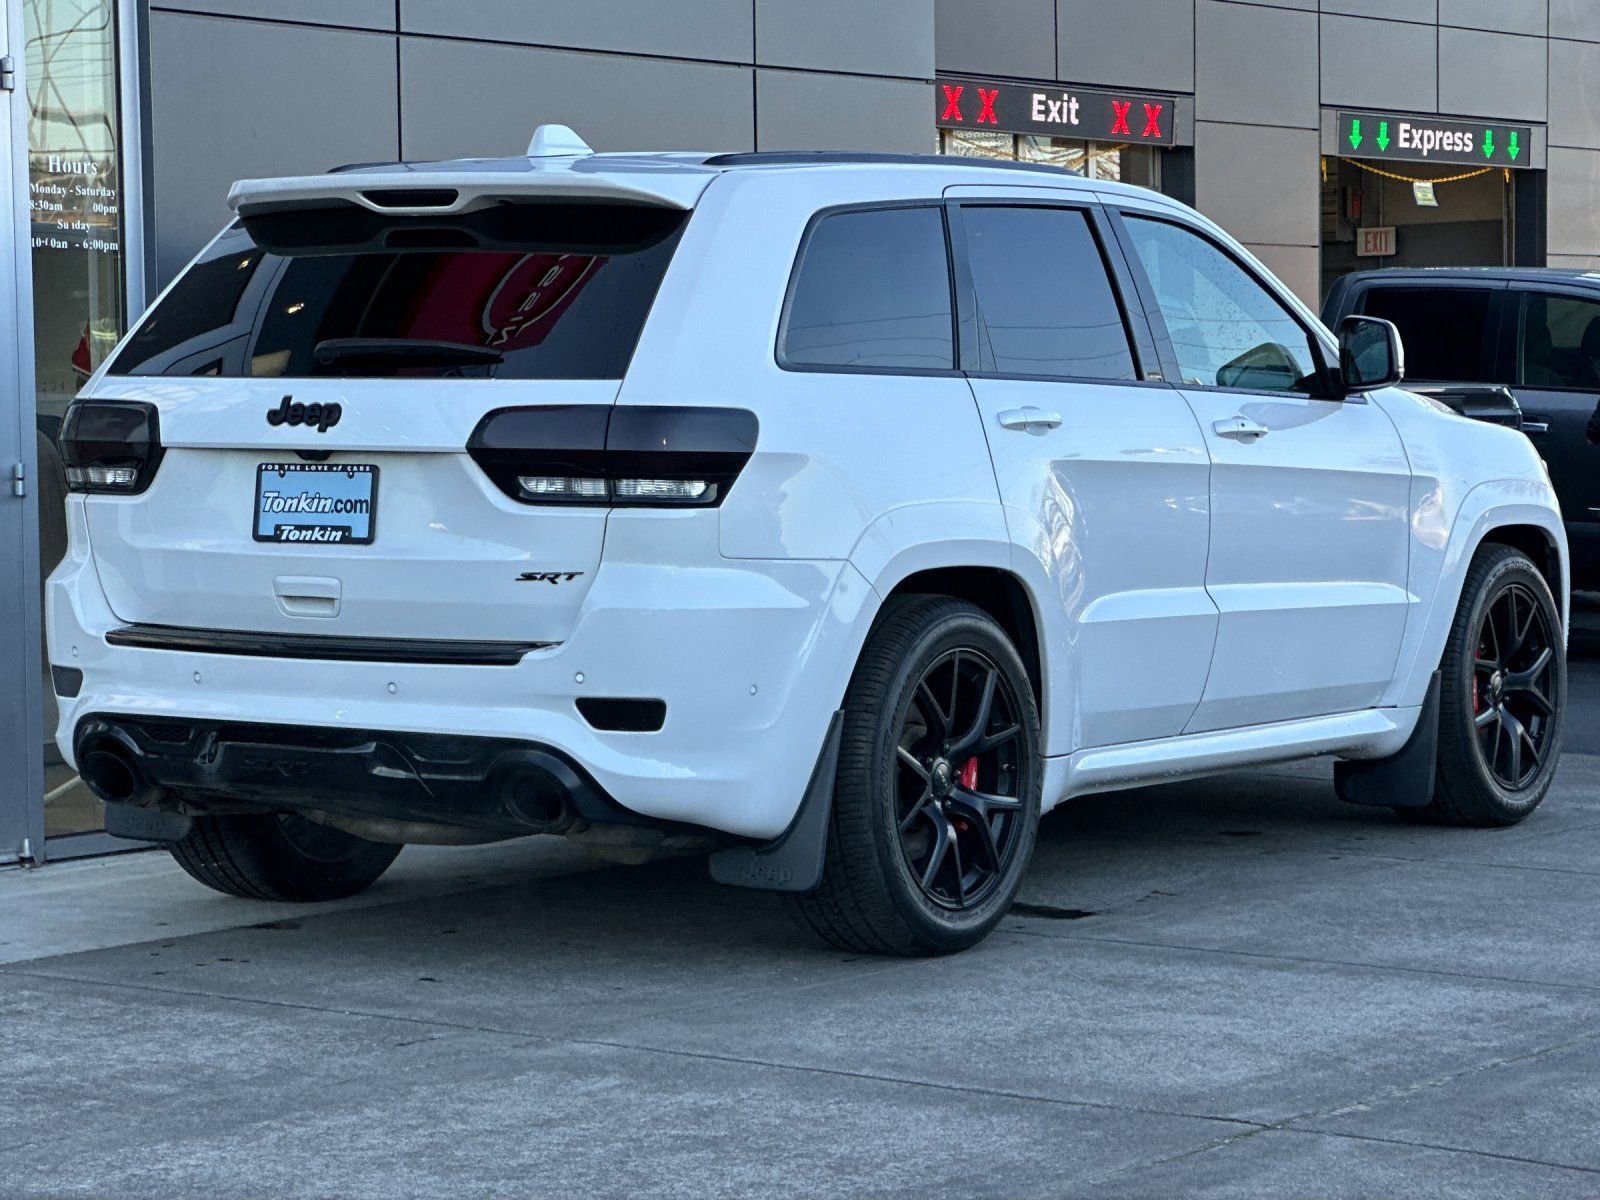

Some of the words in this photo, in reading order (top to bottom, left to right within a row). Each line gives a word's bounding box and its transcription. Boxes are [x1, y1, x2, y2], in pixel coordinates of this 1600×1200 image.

[1031, 92, 1080, 125] Exit
[1398, 122, 1474, 157] Express
[48, 155, 98, 175] Hours
[30, 183, 67, 198] Monday
[75, 184, 116, 200] Saturday
[83, 239, 119, 252] 6:00pm
[1363, 230, 1391, 253] EXIT
[266, 394, 343, 433] Jeep
[262, 490, 370, 514] Tonkin.com
[280, 525, 343, 542] Tonkin
[515, 571, 585, 585] SRT
